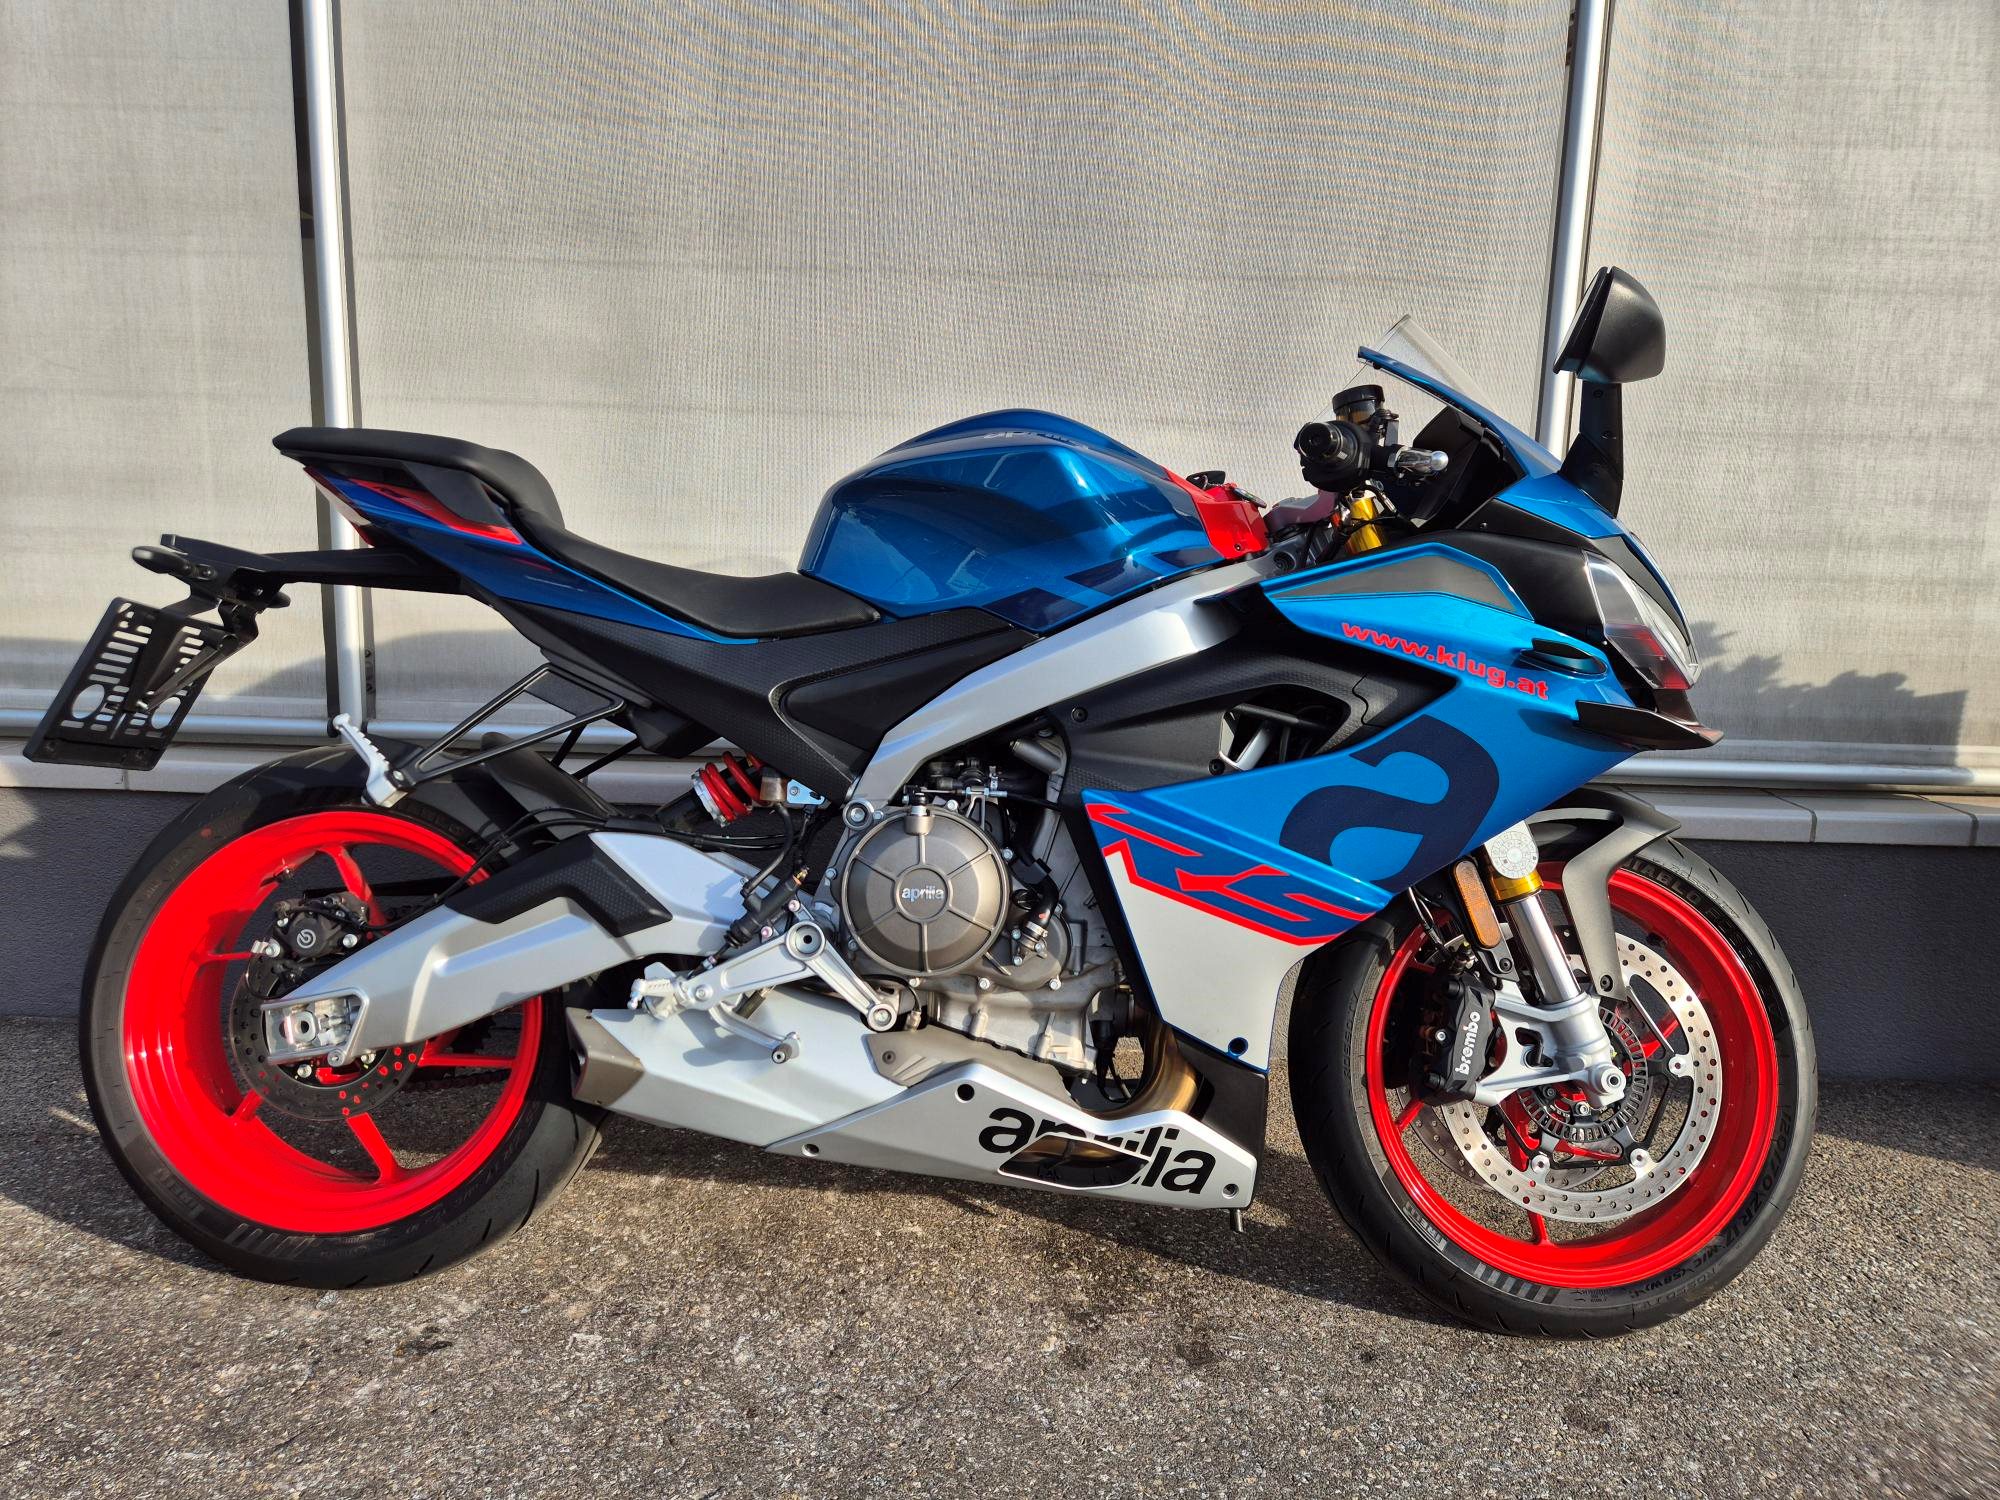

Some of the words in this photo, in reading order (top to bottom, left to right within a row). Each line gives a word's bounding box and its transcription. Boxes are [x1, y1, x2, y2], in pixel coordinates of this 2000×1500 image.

[1341, 623, 1549, 700] www.klug.at
[902, 885, 944, 902] aprilia
[1454, 1011, 1481, 1076] brembo
